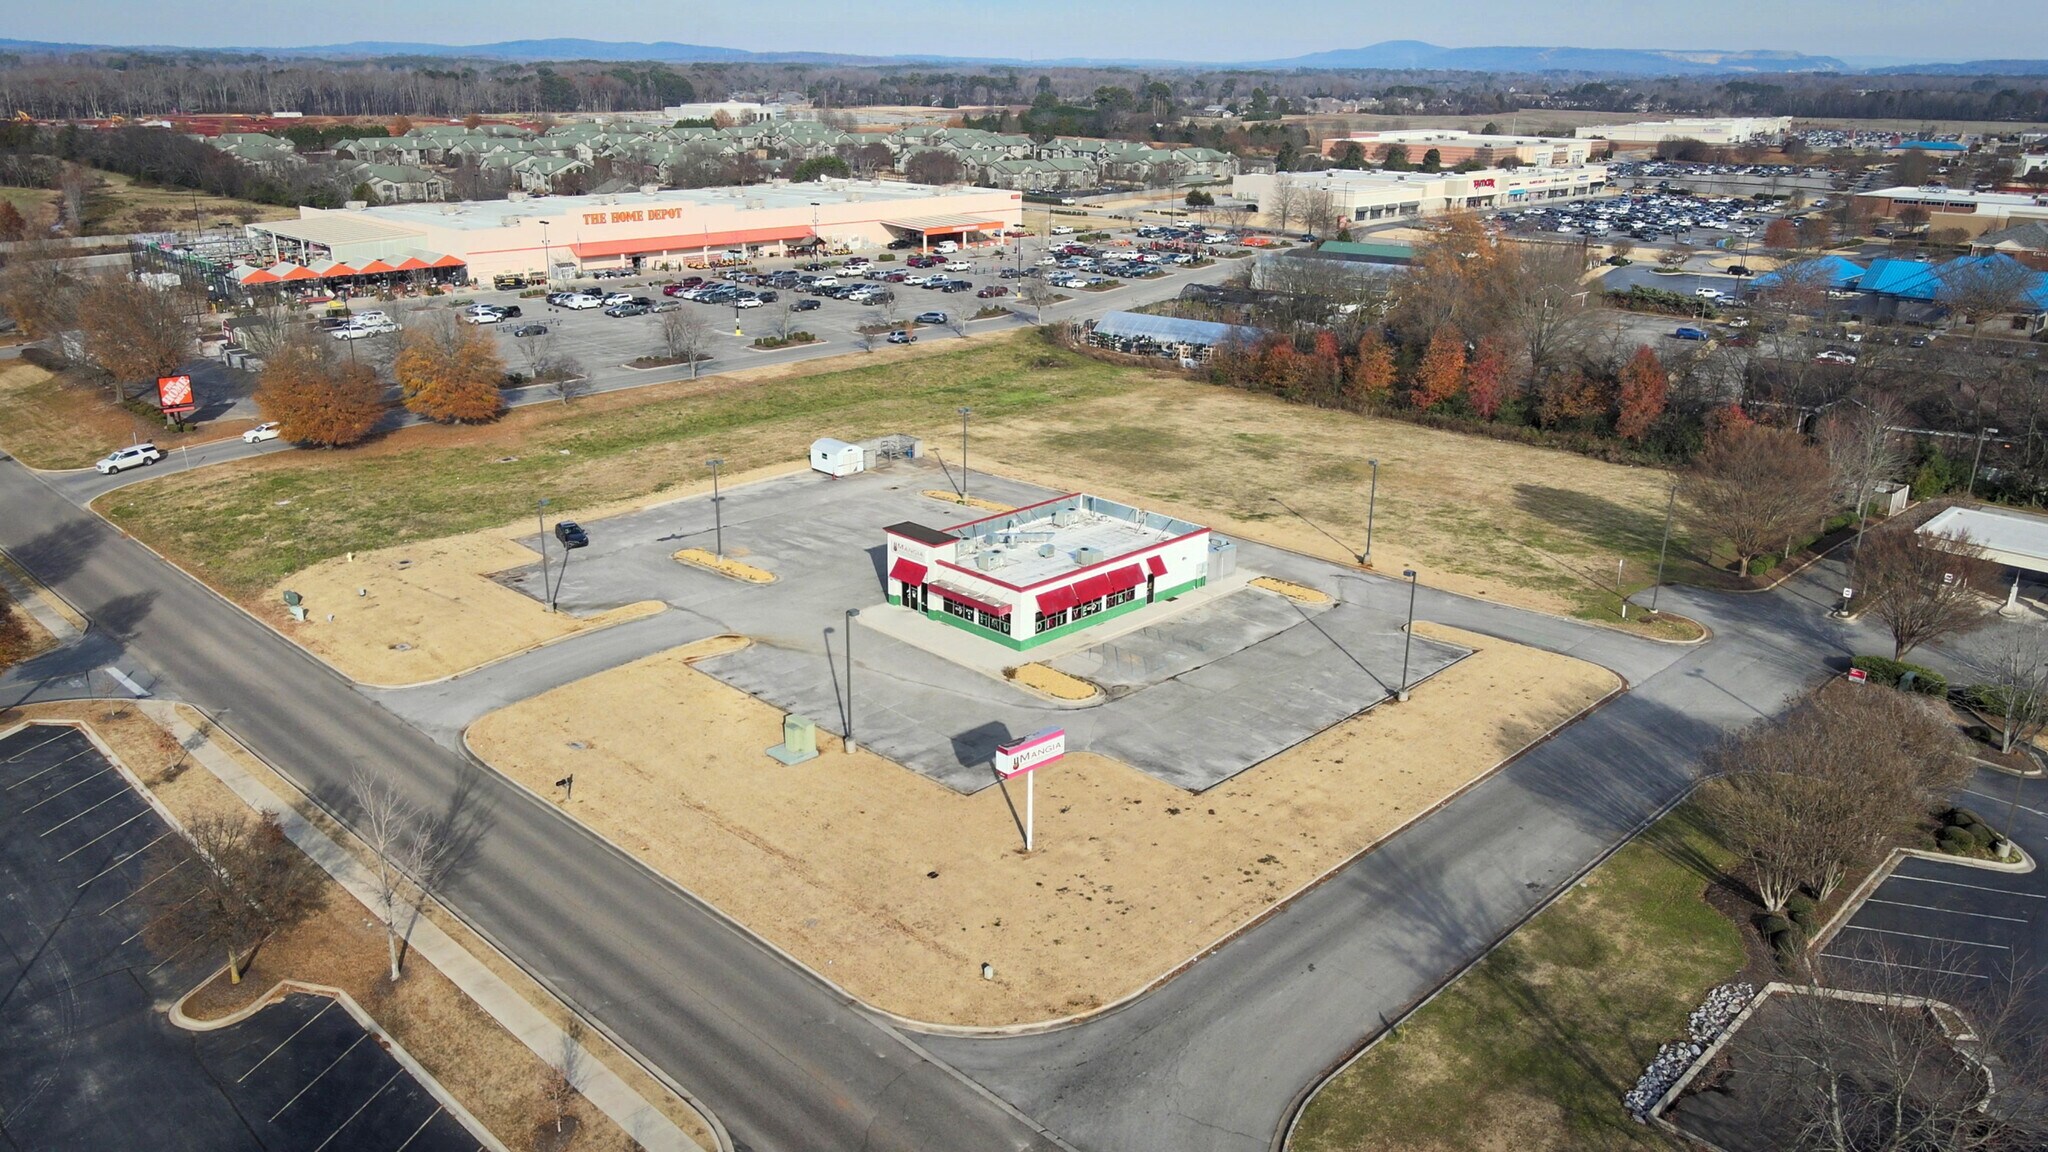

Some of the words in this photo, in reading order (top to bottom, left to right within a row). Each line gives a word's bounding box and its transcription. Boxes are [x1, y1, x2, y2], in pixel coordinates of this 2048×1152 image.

[583, 213, 606, 225] THE
[611, 210, 643, 223] HOME
[648, 208, 682, 220] DEPOT
[162, 376, 190, 405] HOME
[1020, 742, 1061, 763] MANGIA
